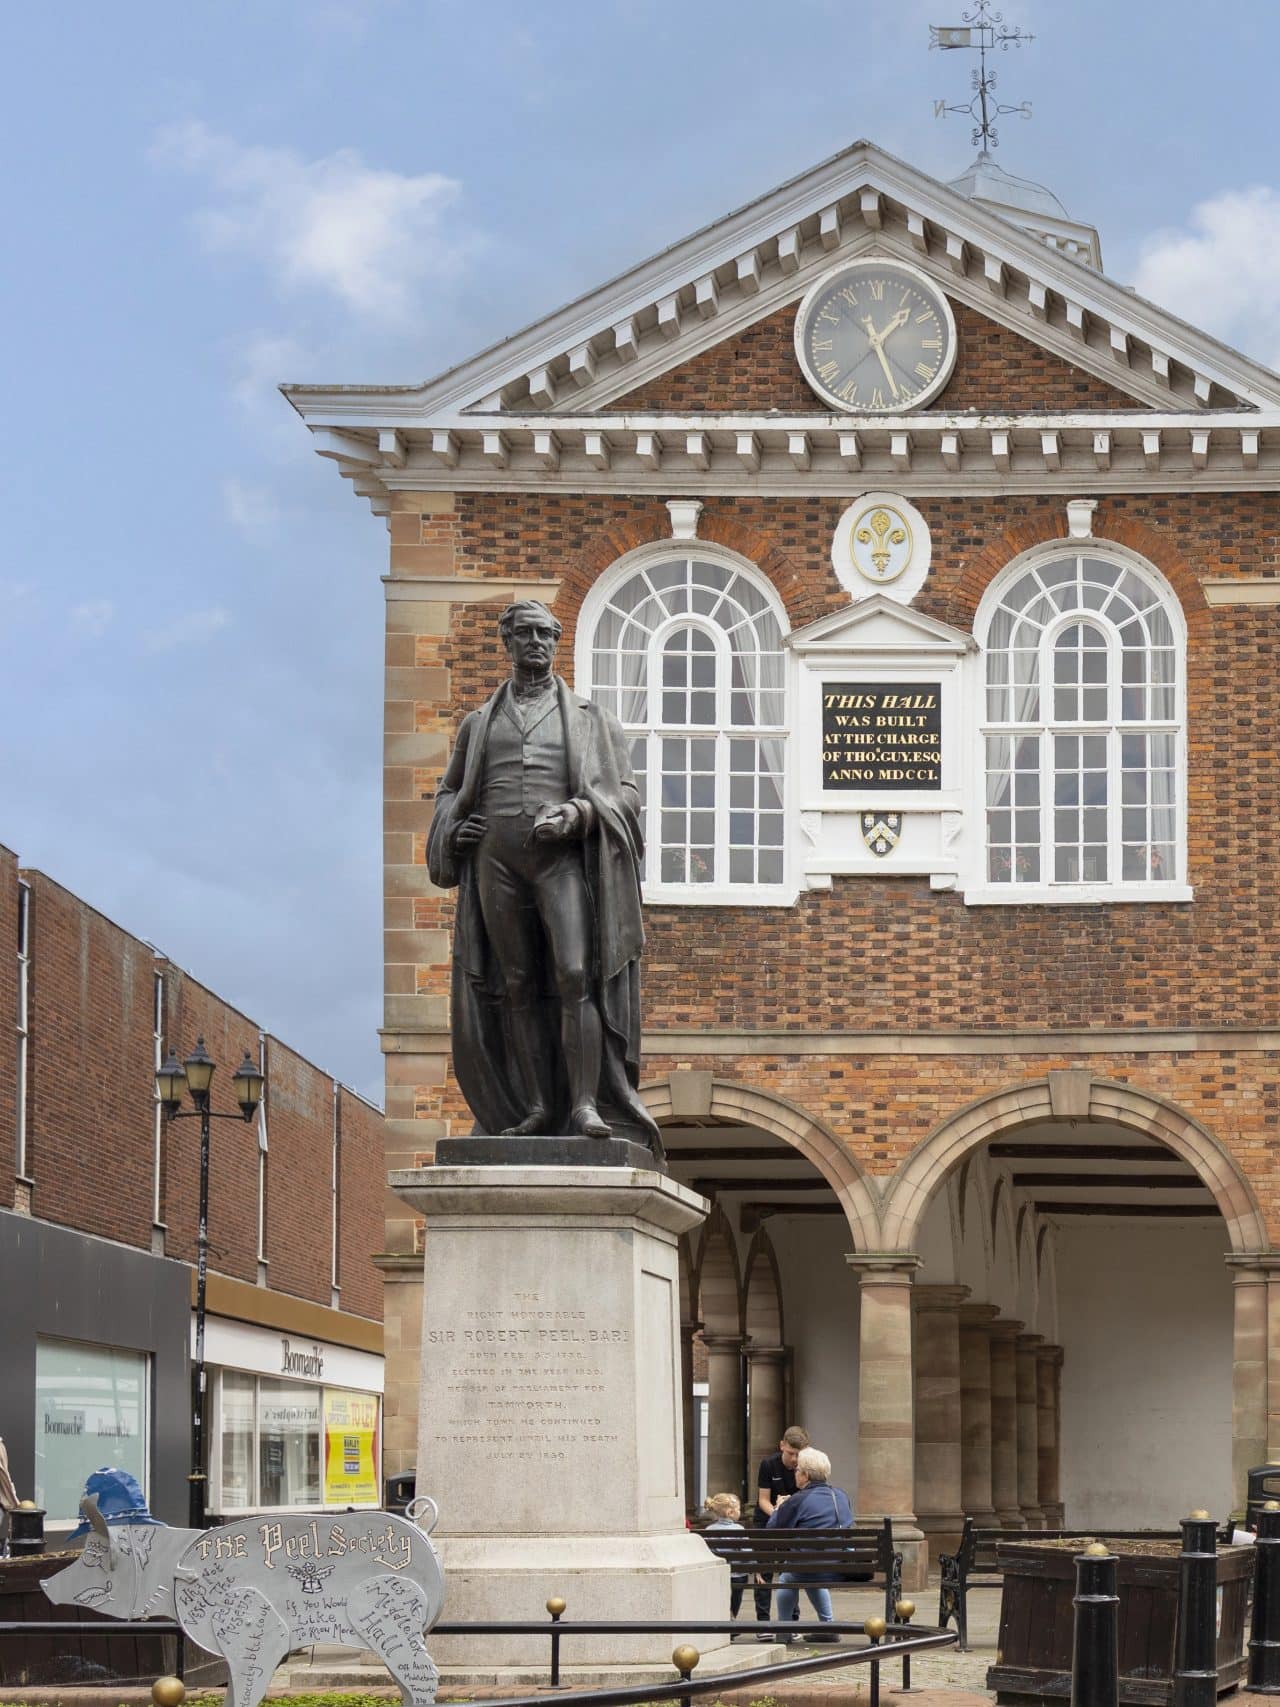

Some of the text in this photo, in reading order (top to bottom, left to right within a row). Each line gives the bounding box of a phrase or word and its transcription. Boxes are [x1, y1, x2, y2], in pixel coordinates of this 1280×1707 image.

[824, 694, 937, 709] THIS HALL
[835, 715, 927, 727] WAS BUILT
[823, 734, 939, 744] AT THE CHARGE
[822, 752, 841, 762] OF
[829, 769, 874, 780] ANNO
[513, 1293, 540, 1301] THE
[467, 1311, 503, 1320] RIGHT
[429, 1330, 456, 1343] SIR
[464, 1329, 530, 1342] ROBERT
[258, 1520, 324, 1569] Peel
[297, 1611, 336, 1625] Like
